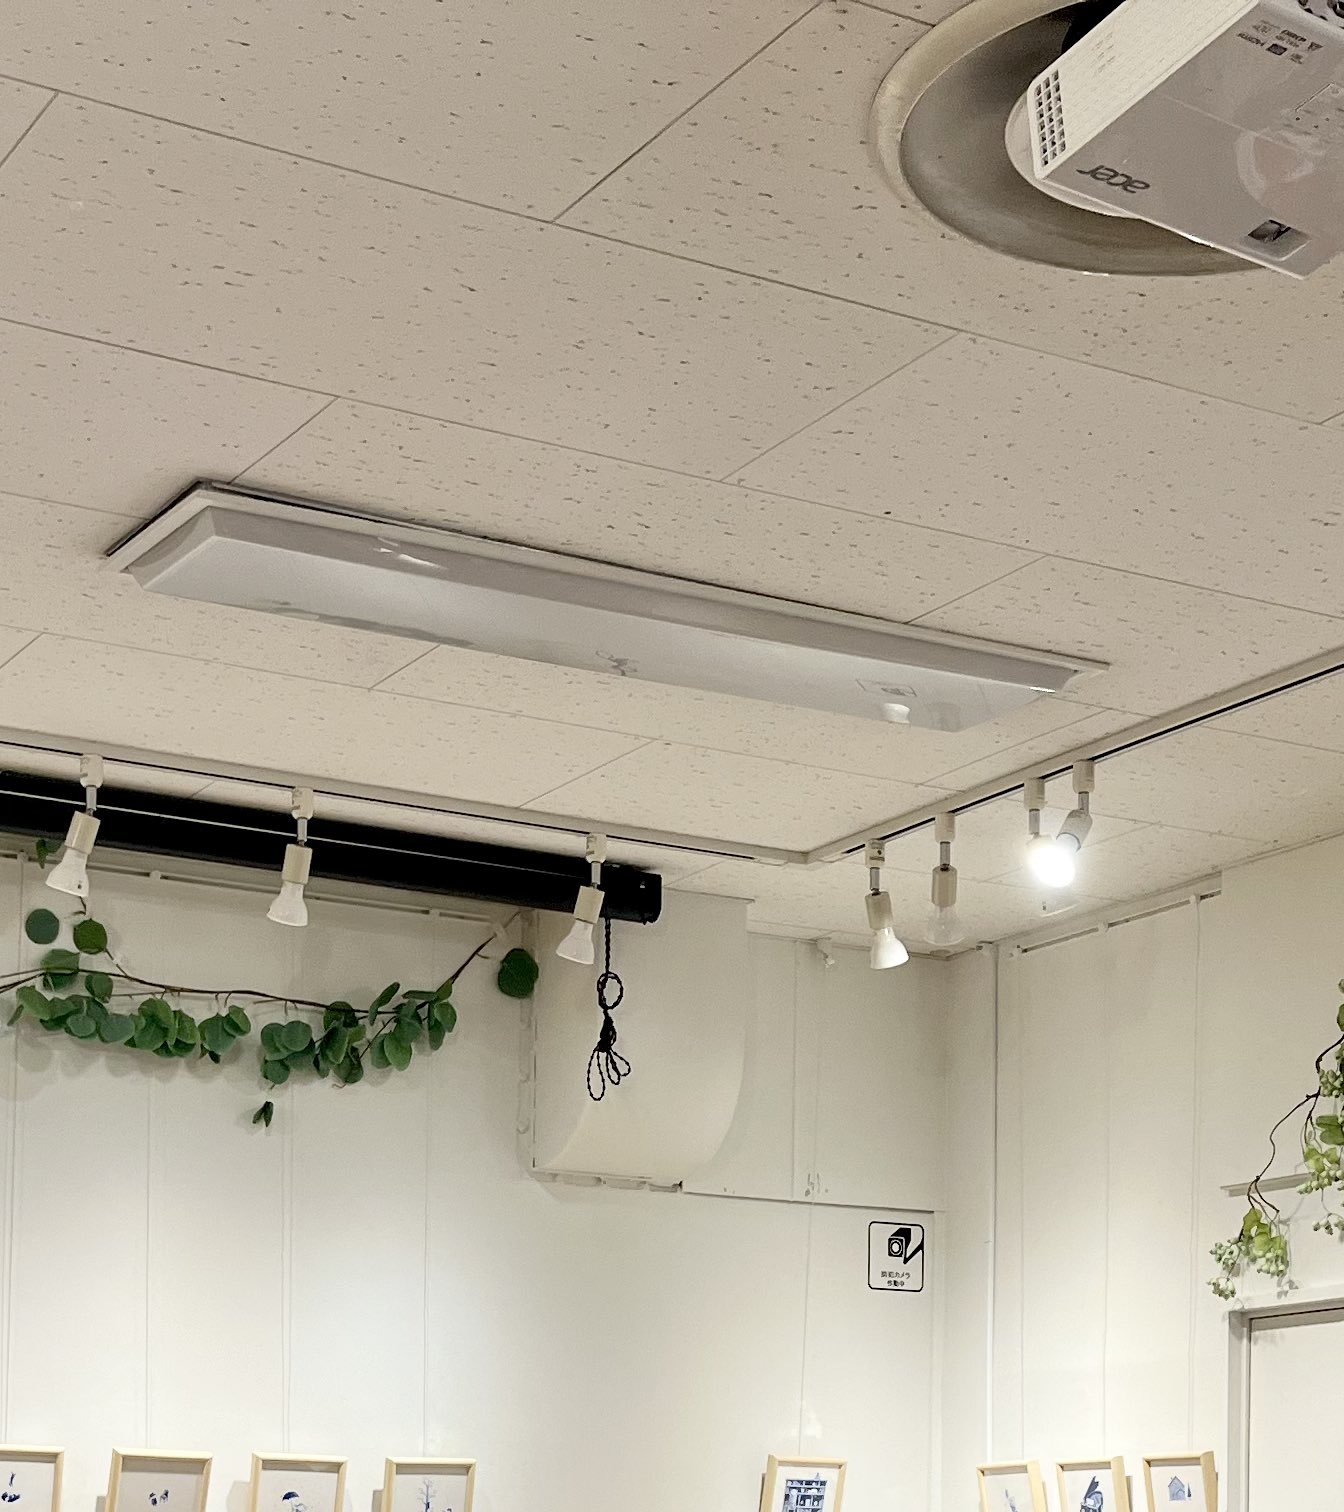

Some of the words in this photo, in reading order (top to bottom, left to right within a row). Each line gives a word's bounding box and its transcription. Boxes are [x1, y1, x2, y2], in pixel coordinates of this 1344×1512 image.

[1076, 164, 1150, 193] acer
[881, 1271, 911, 1279] 防犯カメラ
